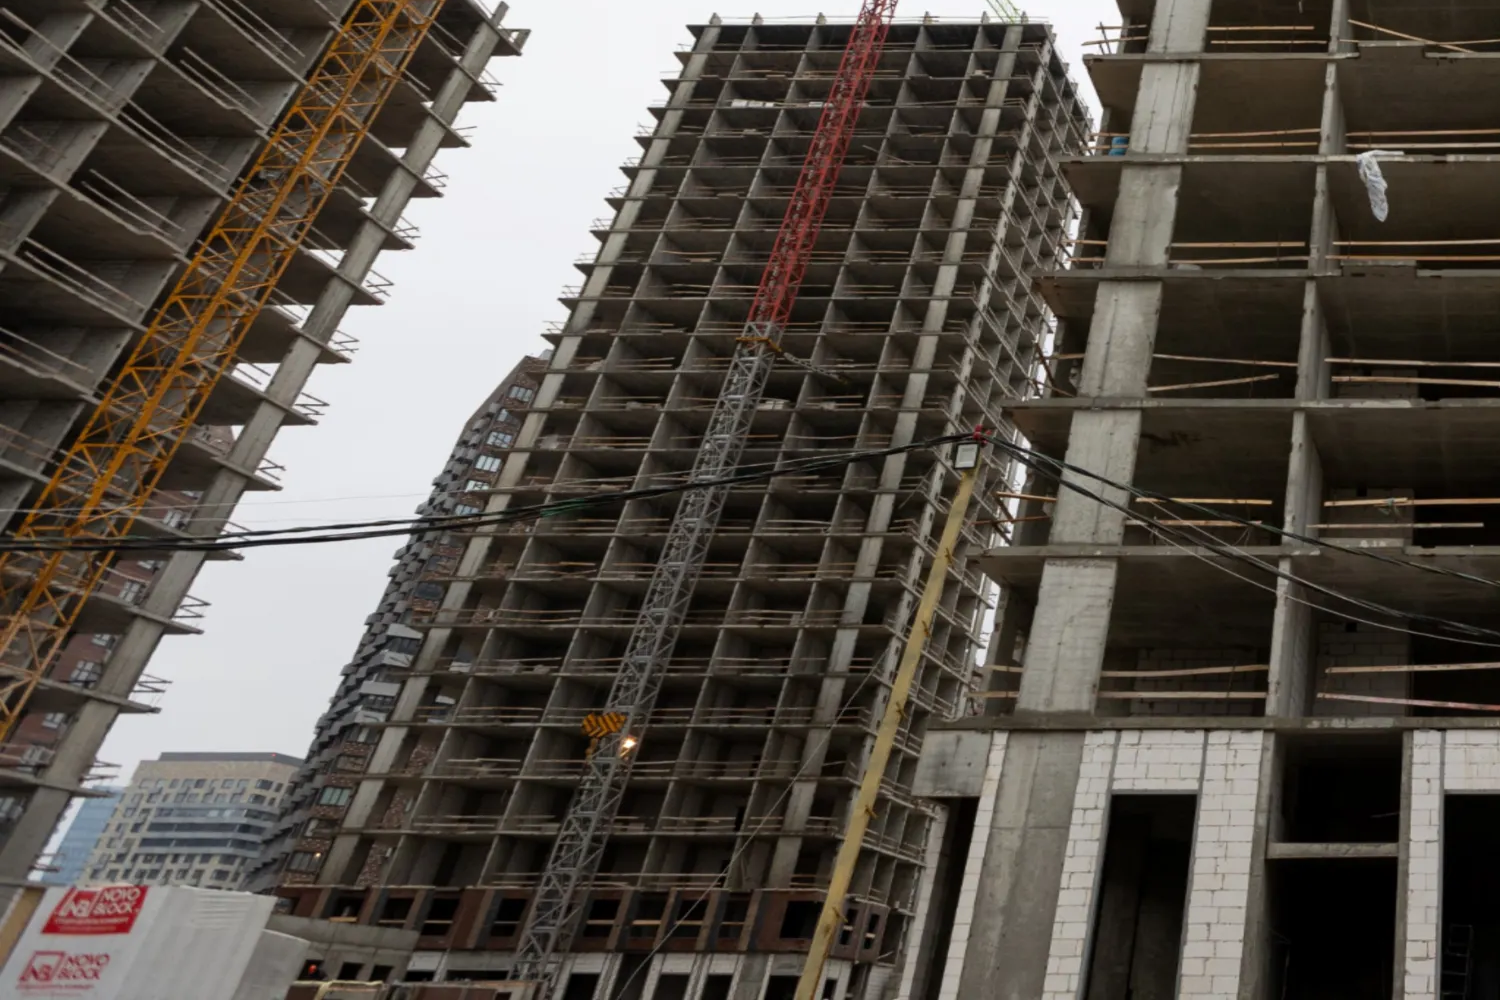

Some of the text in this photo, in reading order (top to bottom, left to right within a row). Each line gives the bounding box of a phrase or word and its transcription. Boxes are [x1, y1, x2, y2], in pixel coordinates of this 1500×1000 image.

[101, 887, 141, 902] NOVO
[92, 902, 133, 916] BLOCK
[66, 952, 110, 967] NOVO
[57, 966, 103, 981] BLOCK
